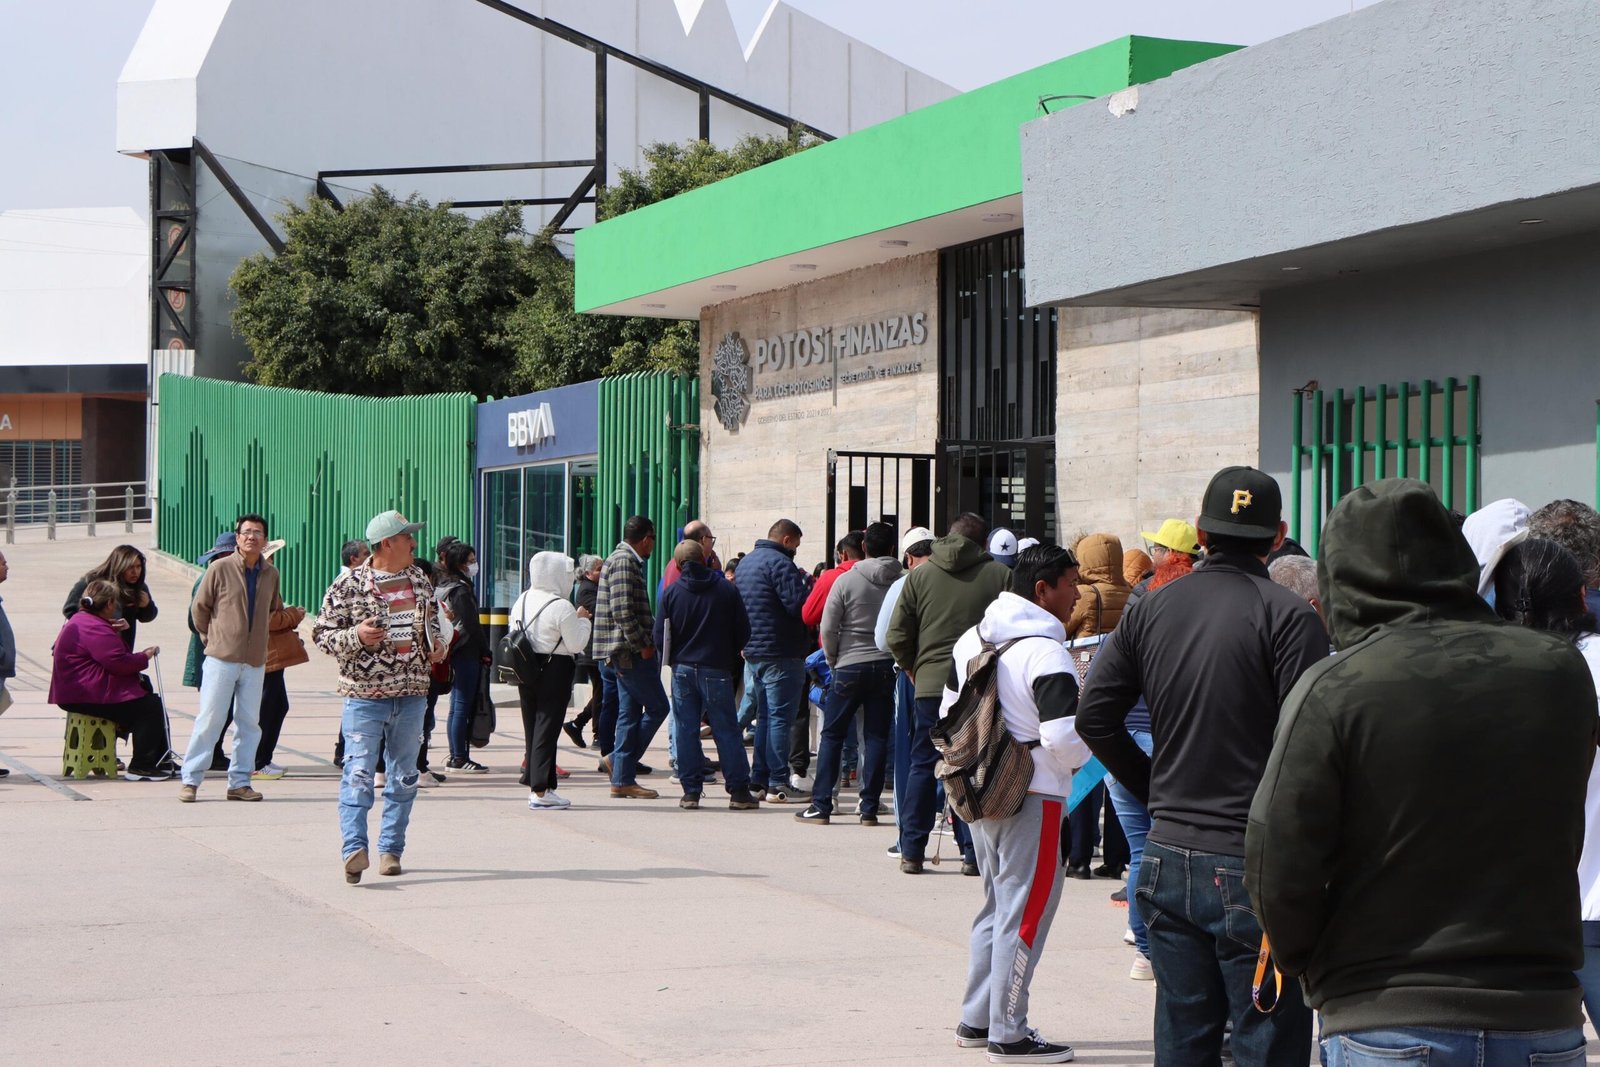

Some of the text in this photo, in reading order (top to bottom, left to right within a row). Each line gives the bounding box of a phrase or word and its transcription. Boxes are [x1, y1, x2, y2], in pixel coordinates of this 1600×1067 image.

[756, 327, 832, 374] POTOSÍ
[837, 312, 927, 359] FINANZAS
[886, 361, 921, 376] FINANZAS
[755, 377, 832, 400] PARA LOS POTOSINOS
[508, 402, 555, 447] BBVA
[1230, 489, 1253, 514] P
